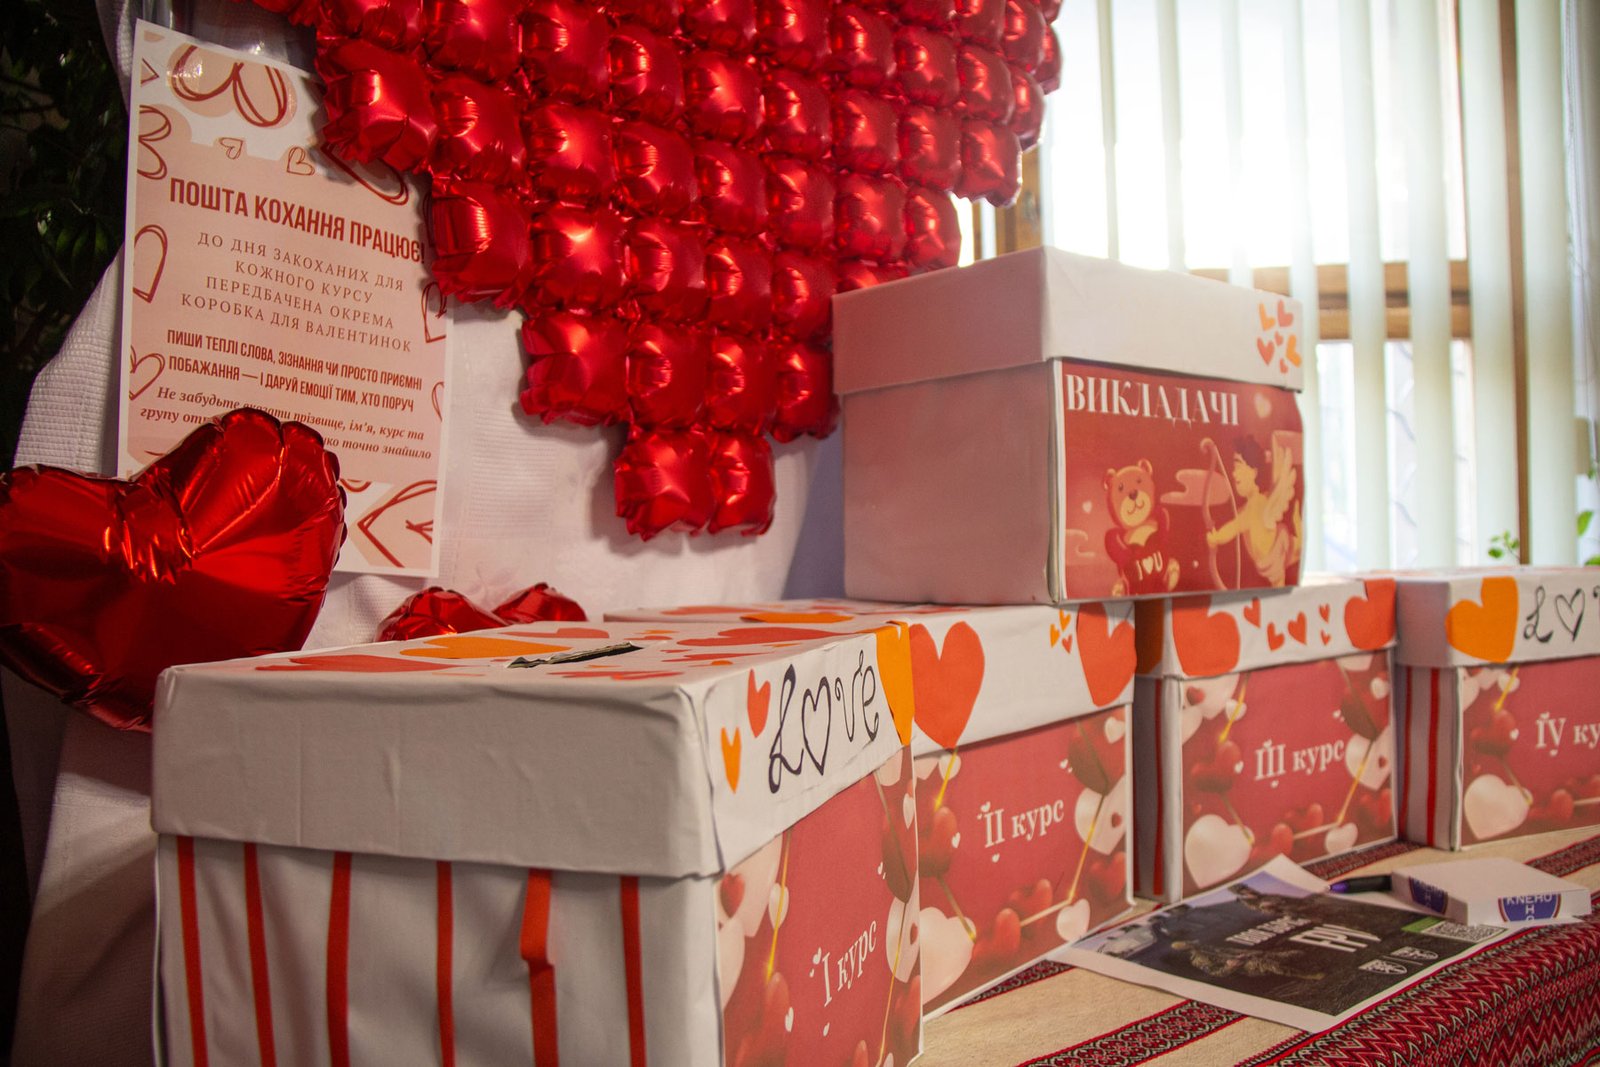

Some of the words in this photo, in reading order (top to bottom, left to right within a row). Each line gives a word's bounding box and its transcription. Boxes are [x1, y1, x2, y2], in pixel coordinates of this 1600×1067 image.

[170, 177, 248, 217] ПОШТА
[255, 195, 345, 241] КОХАННЯ
[350, 220, 425, 264] ПРАЦЮЄ!
[197, 232, 223, 247] ДО
[231, 238, 266, 257] ДНЯ
[273, 247, 368, 283] ЗАКОХАНИХ
[375, 274, 403, 291] ДЛЯ
[235, 260, 314, 291] КОЖНОГО
[321, 282, 373, 303] КУРСУ
[181, 293, 264, 321] КОРОБКА
[270, 312, 299, 330] ДЛЯ
[306, 320, 411, 352] ВАЛЕНТИНОК
[206, 276, 322, 314] ПЕРЕДБАЧЕНА
[330, 305, 393, 329] ОКРЕМА
[167, 329, 203, 348] ПИШИ
[205, 335, 238, 355] ТЕПЛІ
[240, 342, 276, 364] СЛОВА,
[278, 351, 323, 373] ЗІЗНАННЯ
[325, 361, 339, 377] ЧИ
[341, 364, 378, 383] ПРОСТО
[380, 371, 422, 391] ПРИЄМНІ
[169, 355, 240, 381] ПОБАЖАННЯ
[265, 372, 298, 393] ДАРУЙ
[300, 380, 334, 400] ЕМОЦІЇ
[335, 387, 358, 405] ТИМ,
[361, 392, 380, 407] ХТО
[382, 395, 414, 412] ПОРУЧ
[157, 386, 176, 400] Не
[179, 392, 240, 410] забудьте
[293, 412, 346, 431] прізвище,
[379, 427, 404, 439] курс
[407, 431, 424, 441] та
[1066, 374, 1239, 430] ВИКЛАДАЧІ
[140, 407, 179, 424] групу
[342, 439, 379, 452] точно
[382, 444, 432, 459] знайшло
[1293, 739, 1345, 775] курс
[1574, 723, 1600, 749] ку
[1012, 799, 1064, 841] курс
[837, 920, 877, 992] курс
